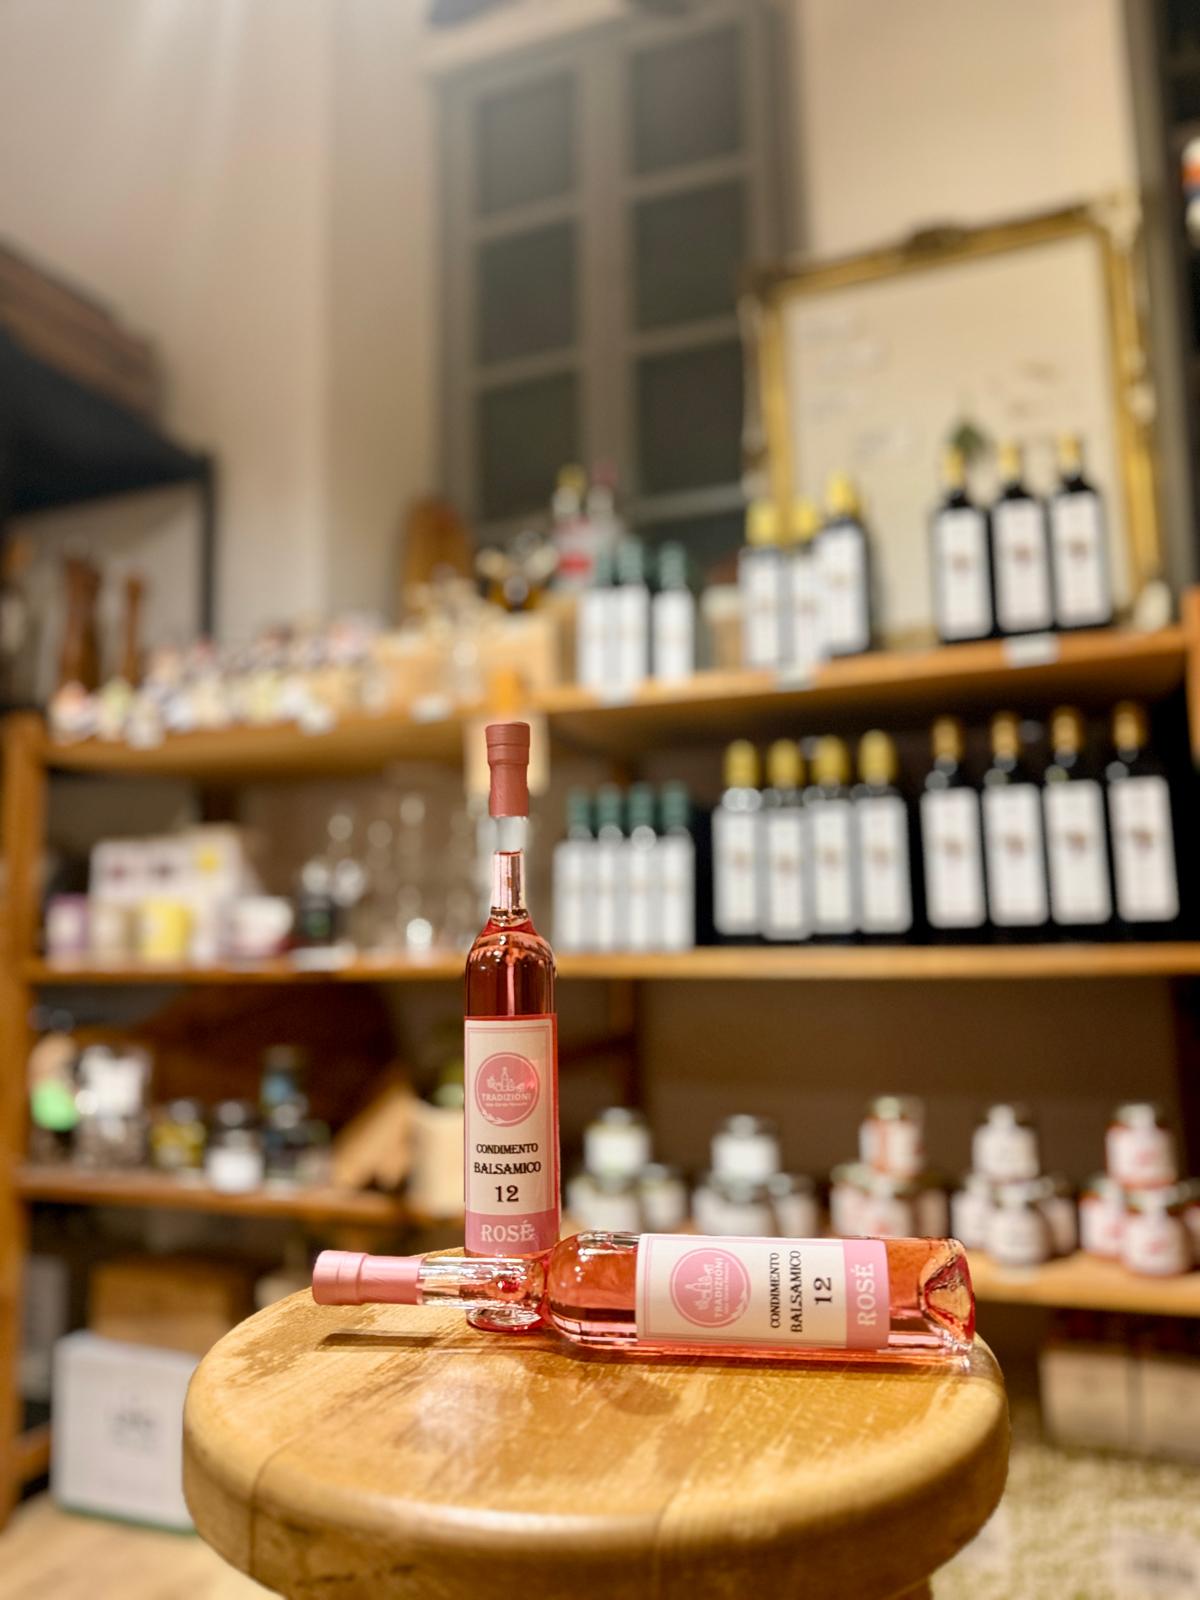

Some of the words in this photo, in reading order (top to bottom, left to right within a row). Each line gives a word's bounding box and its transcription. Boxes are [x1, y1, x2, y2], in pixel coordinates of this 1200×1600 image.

[476, 1143, 539, 1154] CONDIMENTO
[474, 1161, 541, 1174] BALSAMICO
[495, 1185, 519, 1202] 12
[481, 1220, 536, 1242] ROSÉ
[714, 1257, 724, 1319] TRADIZIONI
[769, 1252, 781, 1329] CONDIMENTO
[789, 1250, 803, 1333] BALSAMICO
[813, 1277, 832, 1305] 12
[850, 1263, 877, 1326] ROSÉ
